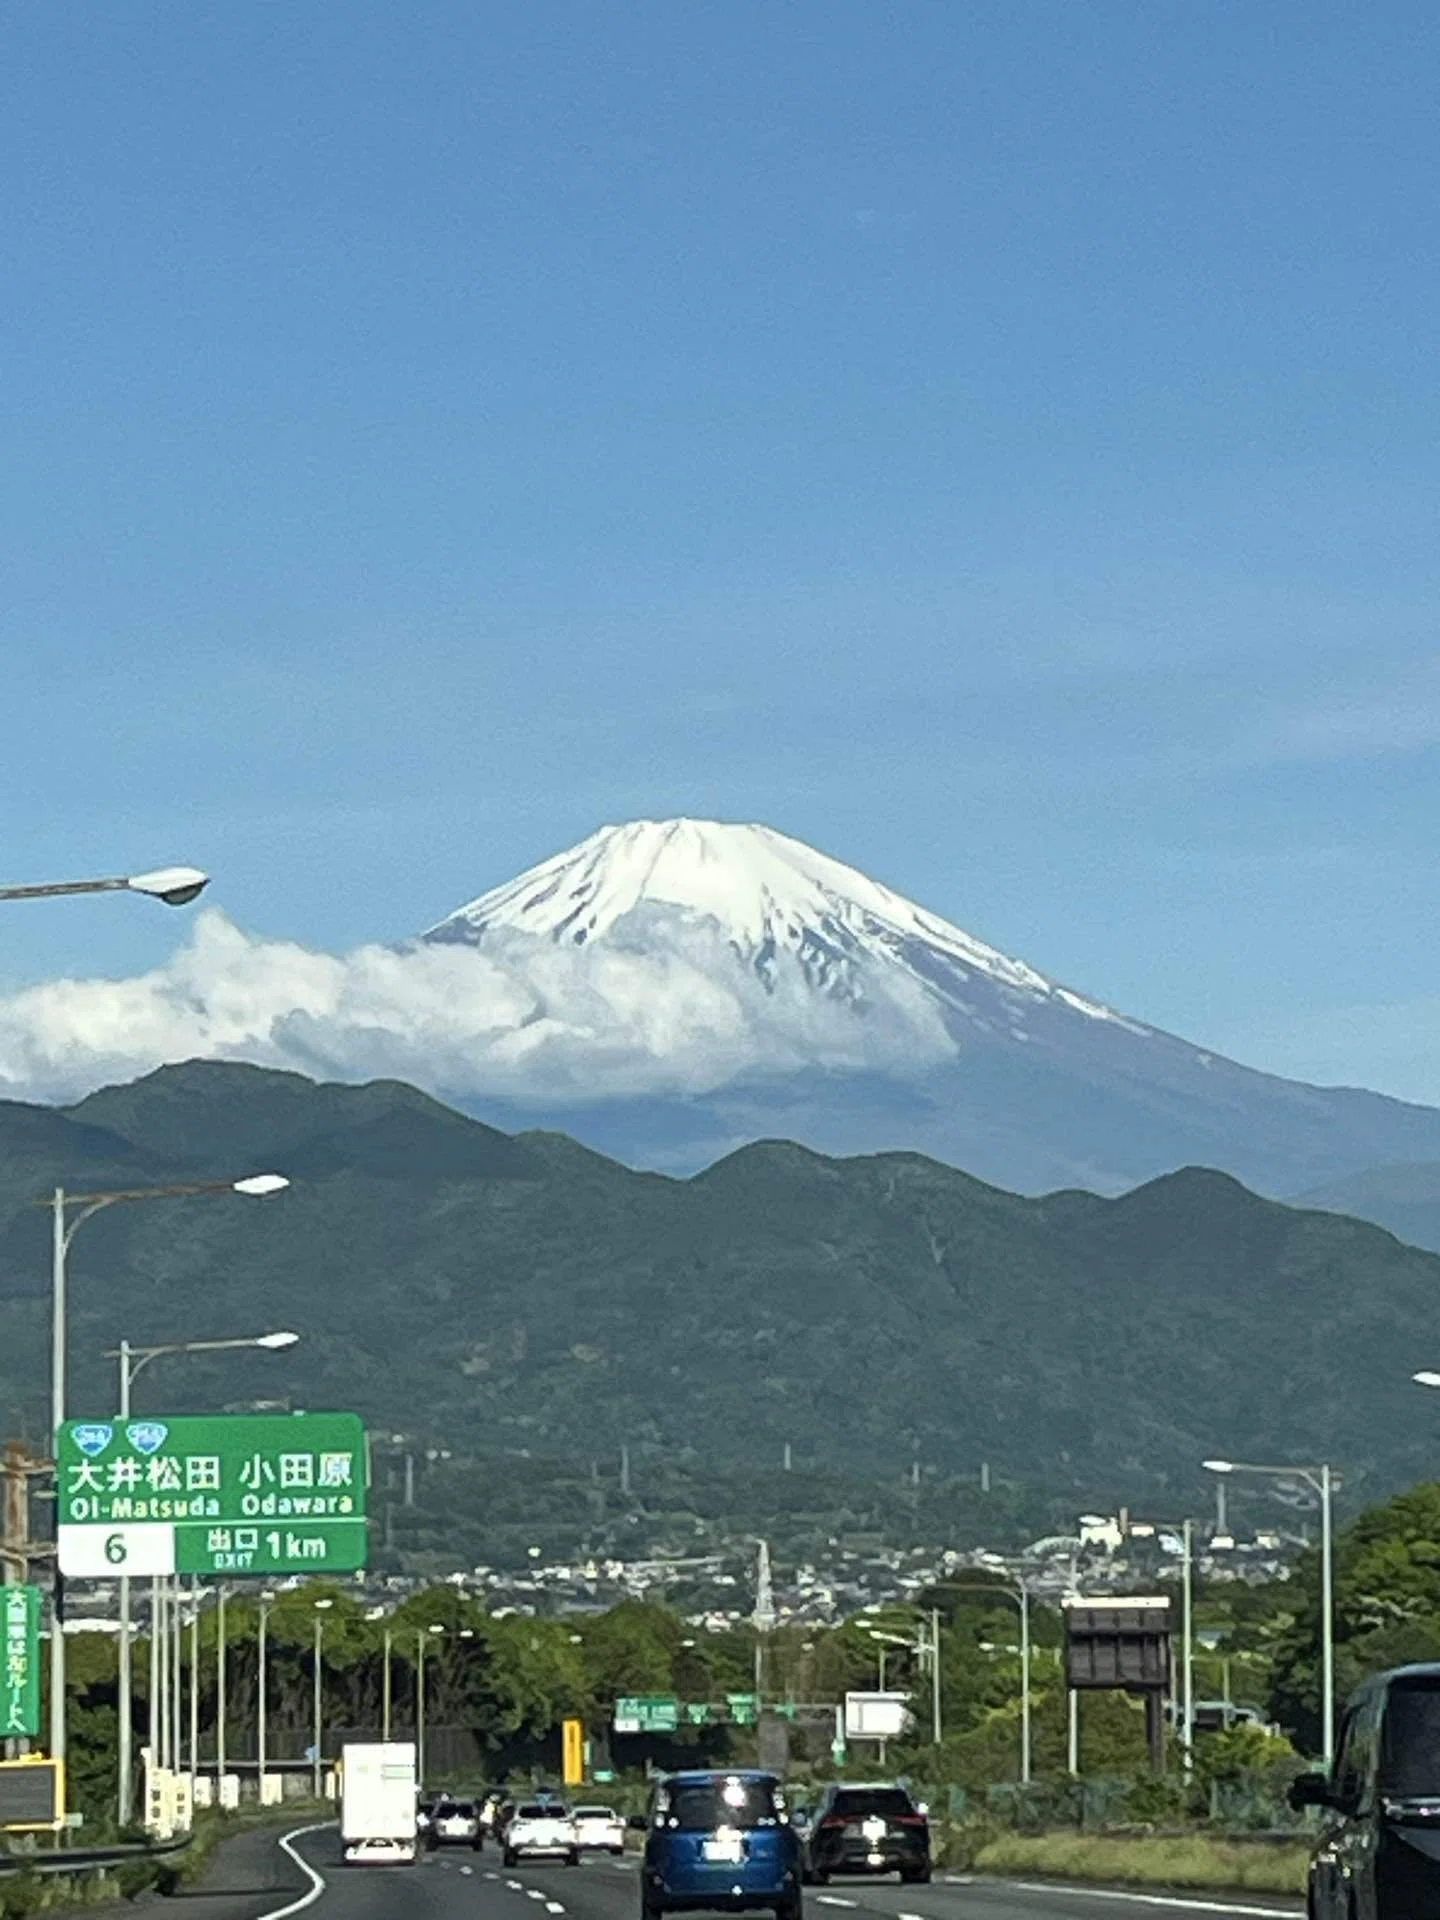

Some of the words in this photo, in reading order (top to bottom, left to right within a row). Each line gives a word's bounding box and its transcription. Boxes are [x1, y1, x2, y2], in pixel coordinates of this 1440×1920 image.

[67, 1456, 220, 1493] 大井松田
[239, 1453, 353, 1489] 小田原
[241, 1493, 353, 1517] Odawara
[104, 1533, 127, 1564] 6
[207, 1528, 258, 1551] 出口
